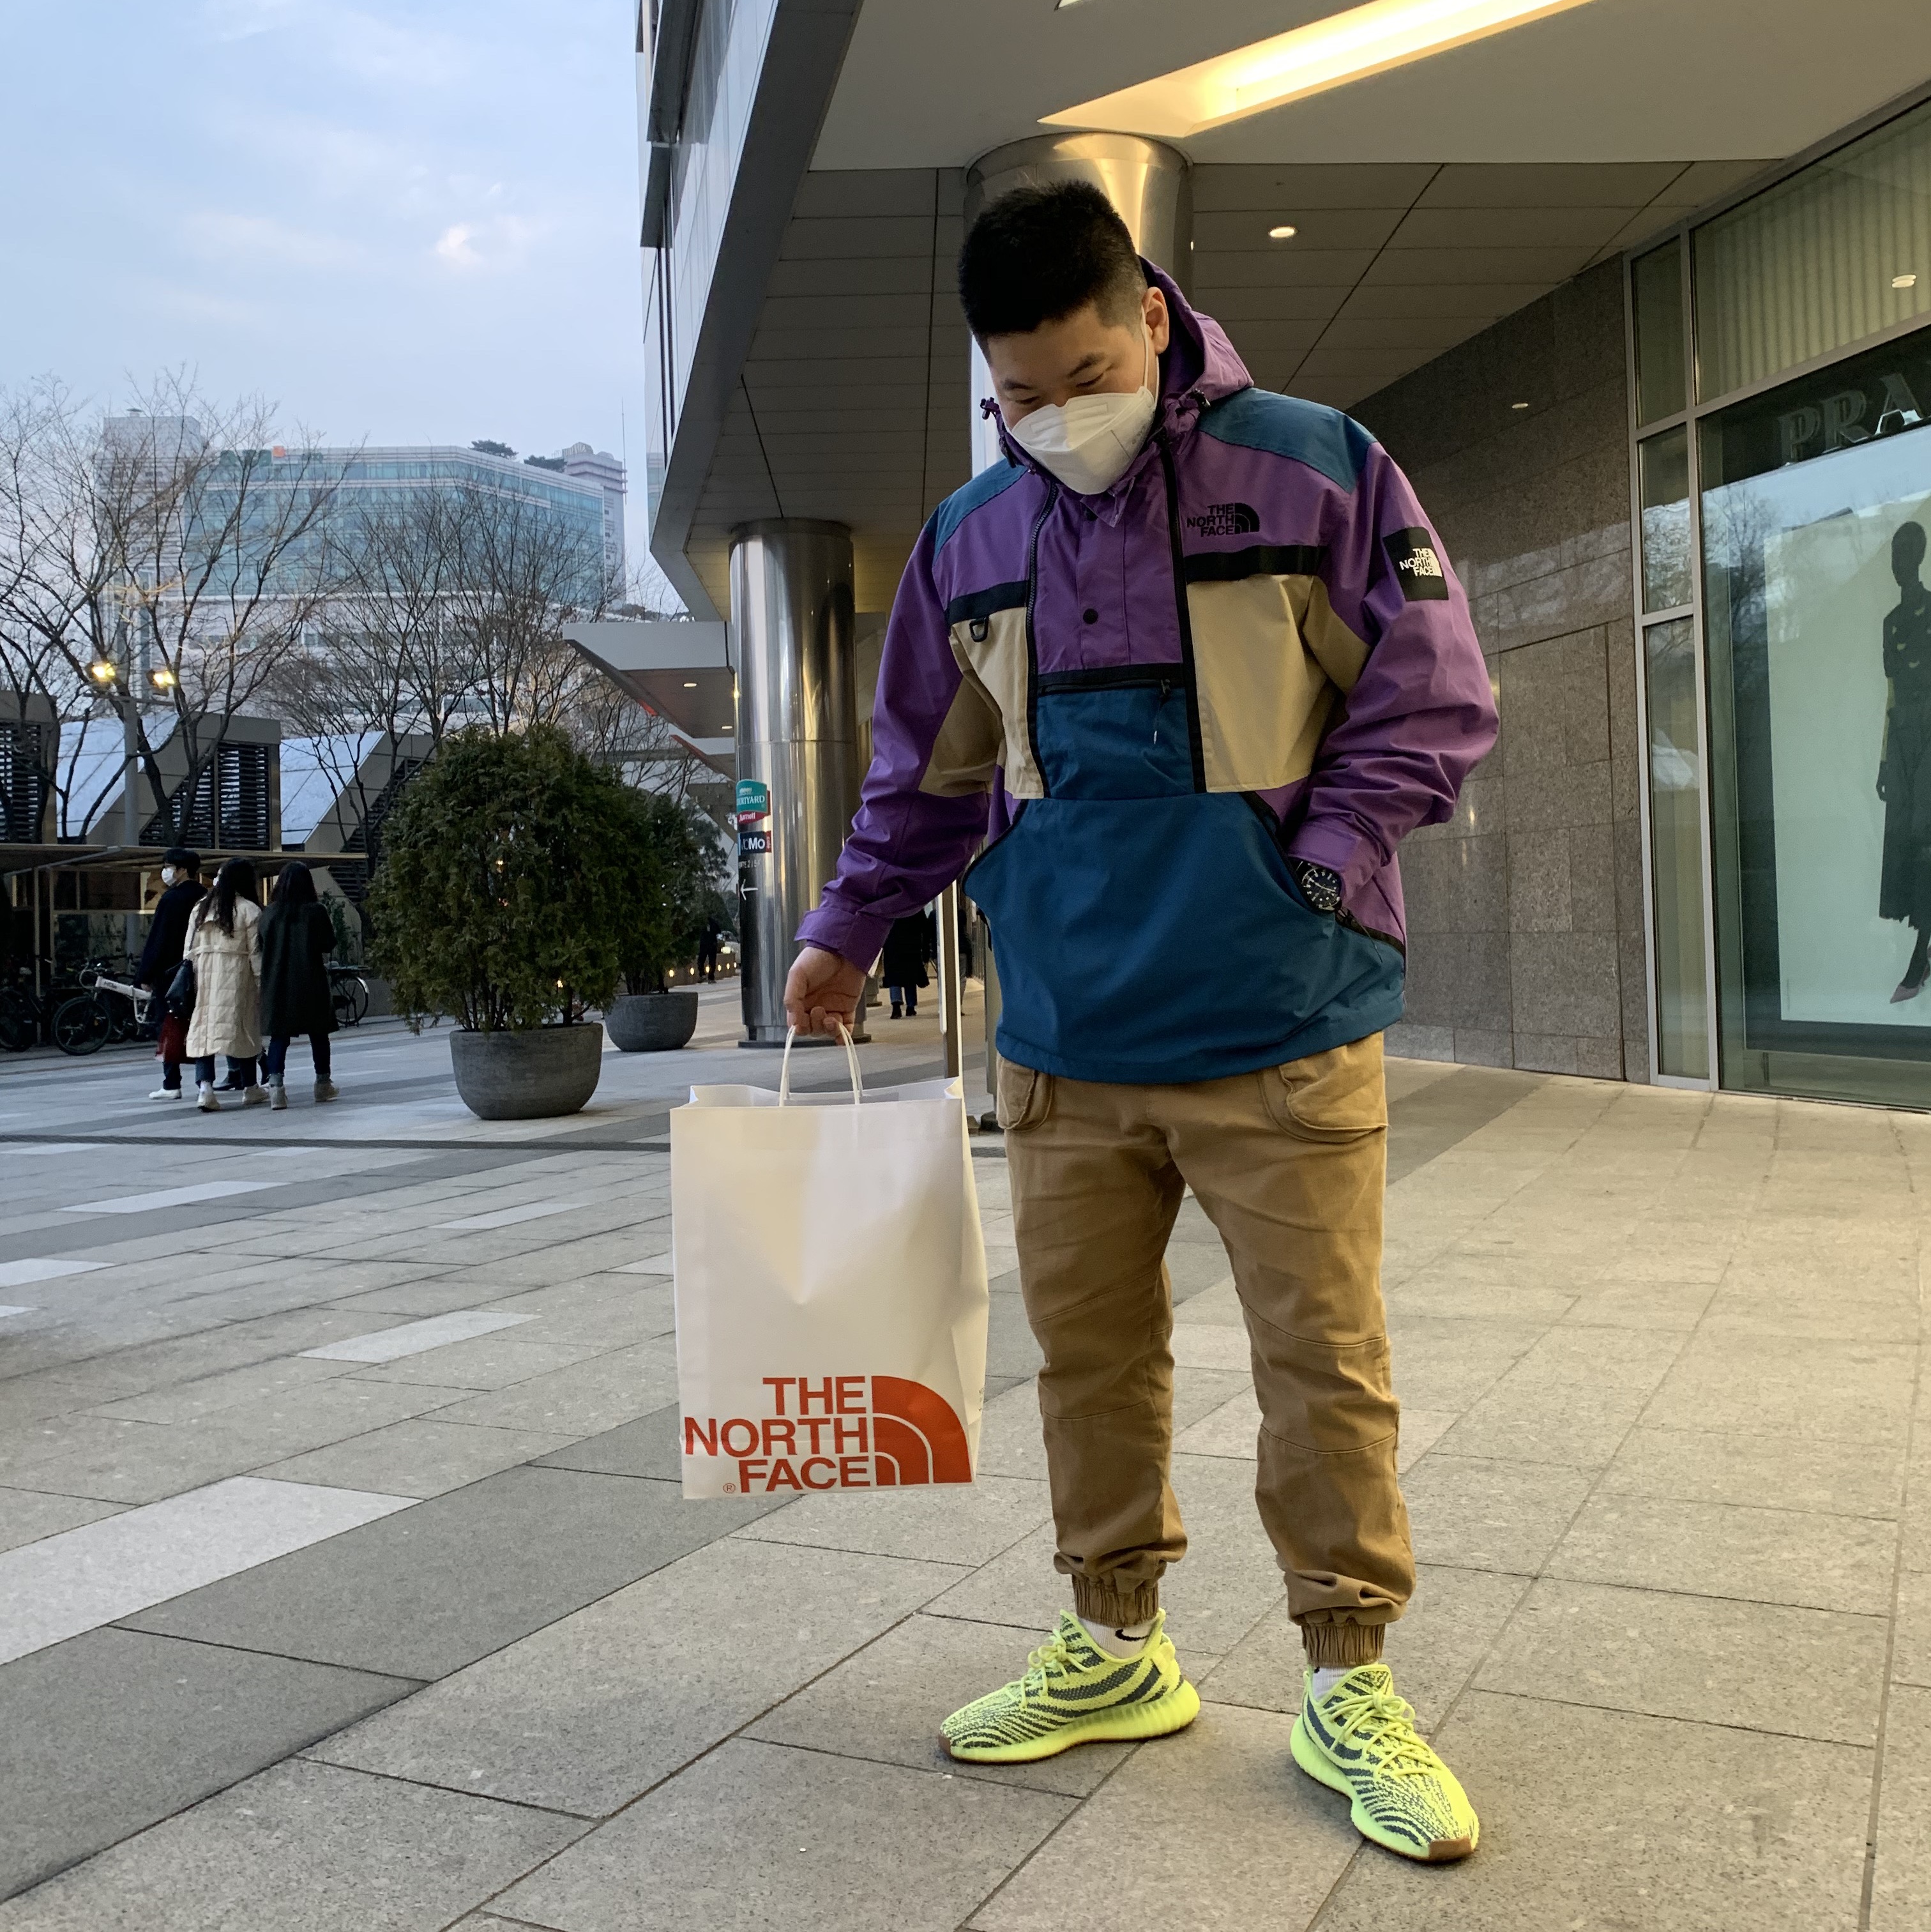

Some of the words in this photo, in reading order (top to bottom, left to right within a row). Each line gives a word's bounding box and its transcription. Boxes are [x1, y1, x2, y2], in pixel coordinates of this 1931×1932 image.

[1208, 503, 1234, 515] THE
[1186, 514, 1234, 528] NORTH
[1200, 525, 1234, 537] FACE
[1412, 548, 1430, 558] THE
[1399, 557, 1431, 570] NORTH
[1412, 566, 1434, 577] FACE
[762, 1376, 867, 1416] THE
[685, 1417, 868, 1457] NORTH
[738, 1456, 871, 1493] FACE
